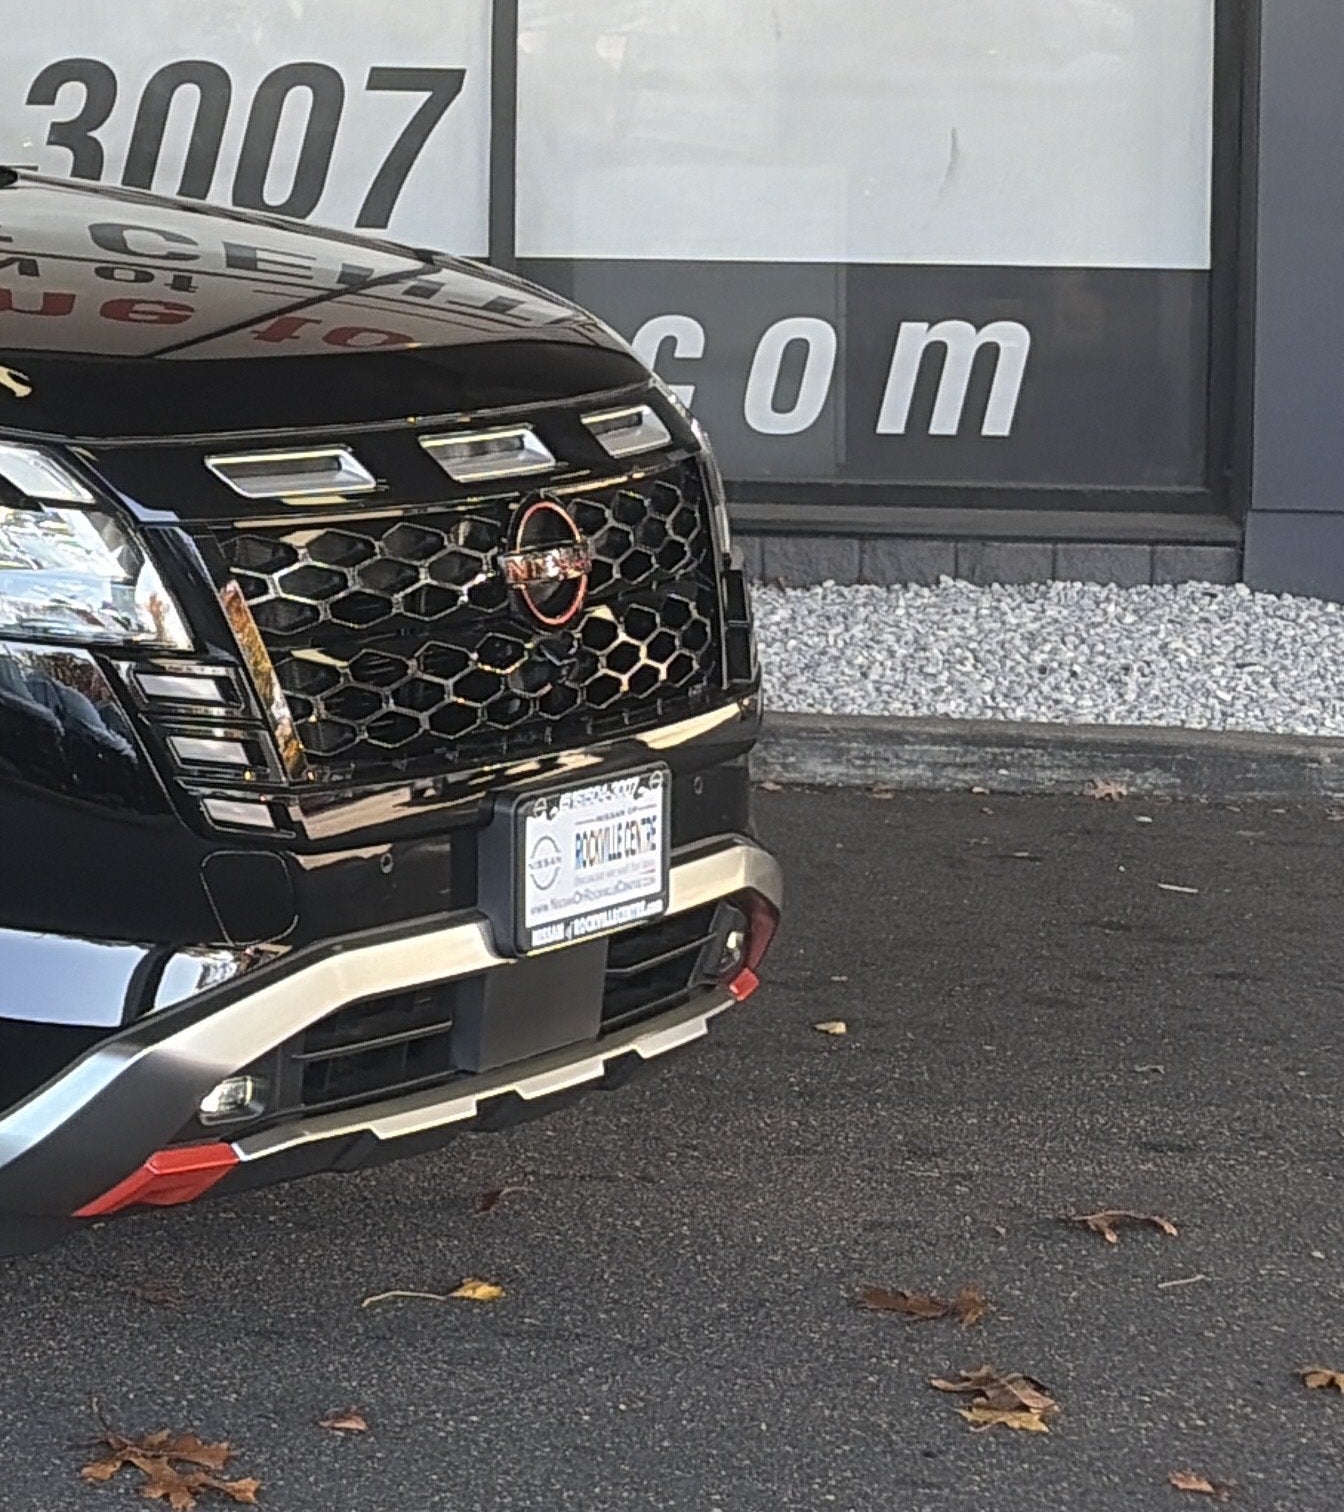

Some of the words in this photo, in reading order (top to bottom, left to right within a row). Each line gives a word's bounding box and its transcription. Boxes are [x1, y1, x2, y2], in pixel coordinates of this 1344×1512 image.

[574, 821, 622, 870] ROCKVILLE
[624, 814, 657, 857] CENTRE
[528, 856, 562, 870] NISSAN
